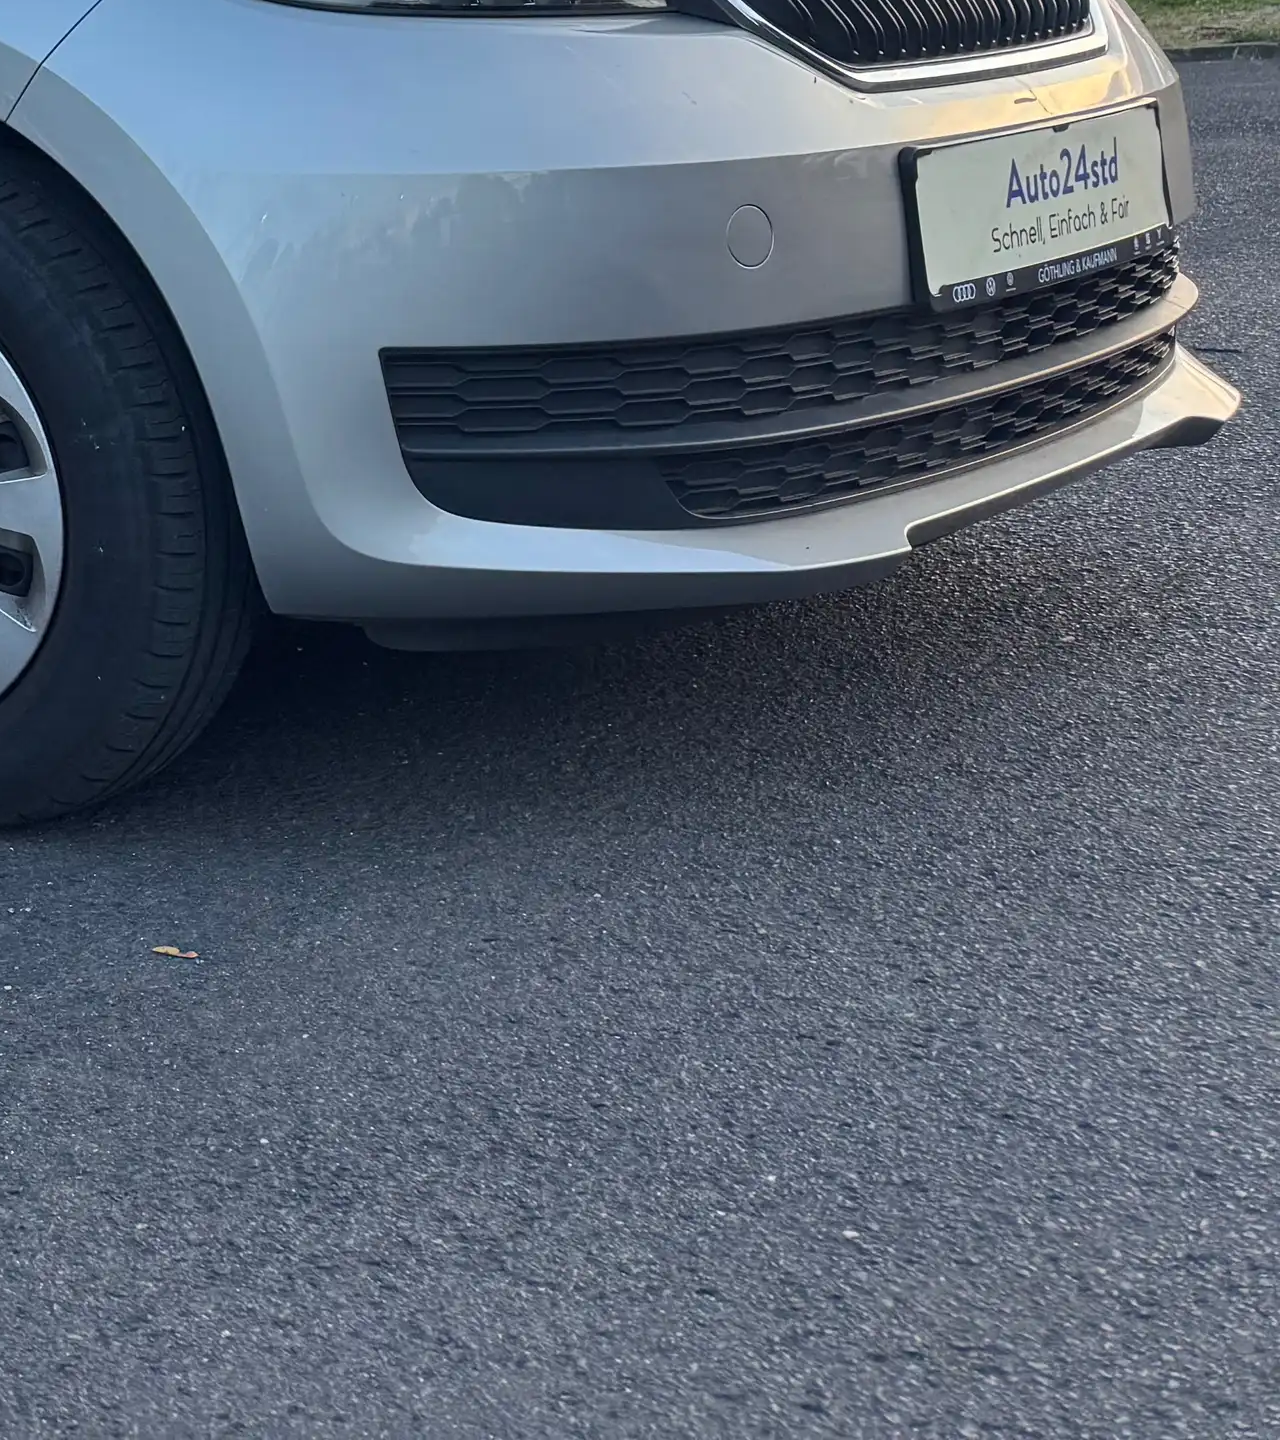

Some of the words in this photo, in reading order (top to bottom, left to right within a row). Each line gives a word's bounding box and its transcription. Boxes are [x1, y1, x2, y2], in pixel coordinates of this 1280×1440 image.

[1006, 137, 1118, 209] Auto24std
[991, 213, 1045, 253] Schnell,
[1050, 204, 1096, 239] Einfach
[1100, 201, 1108, 223] &
[1112, 195, 1129, 221] Fair
